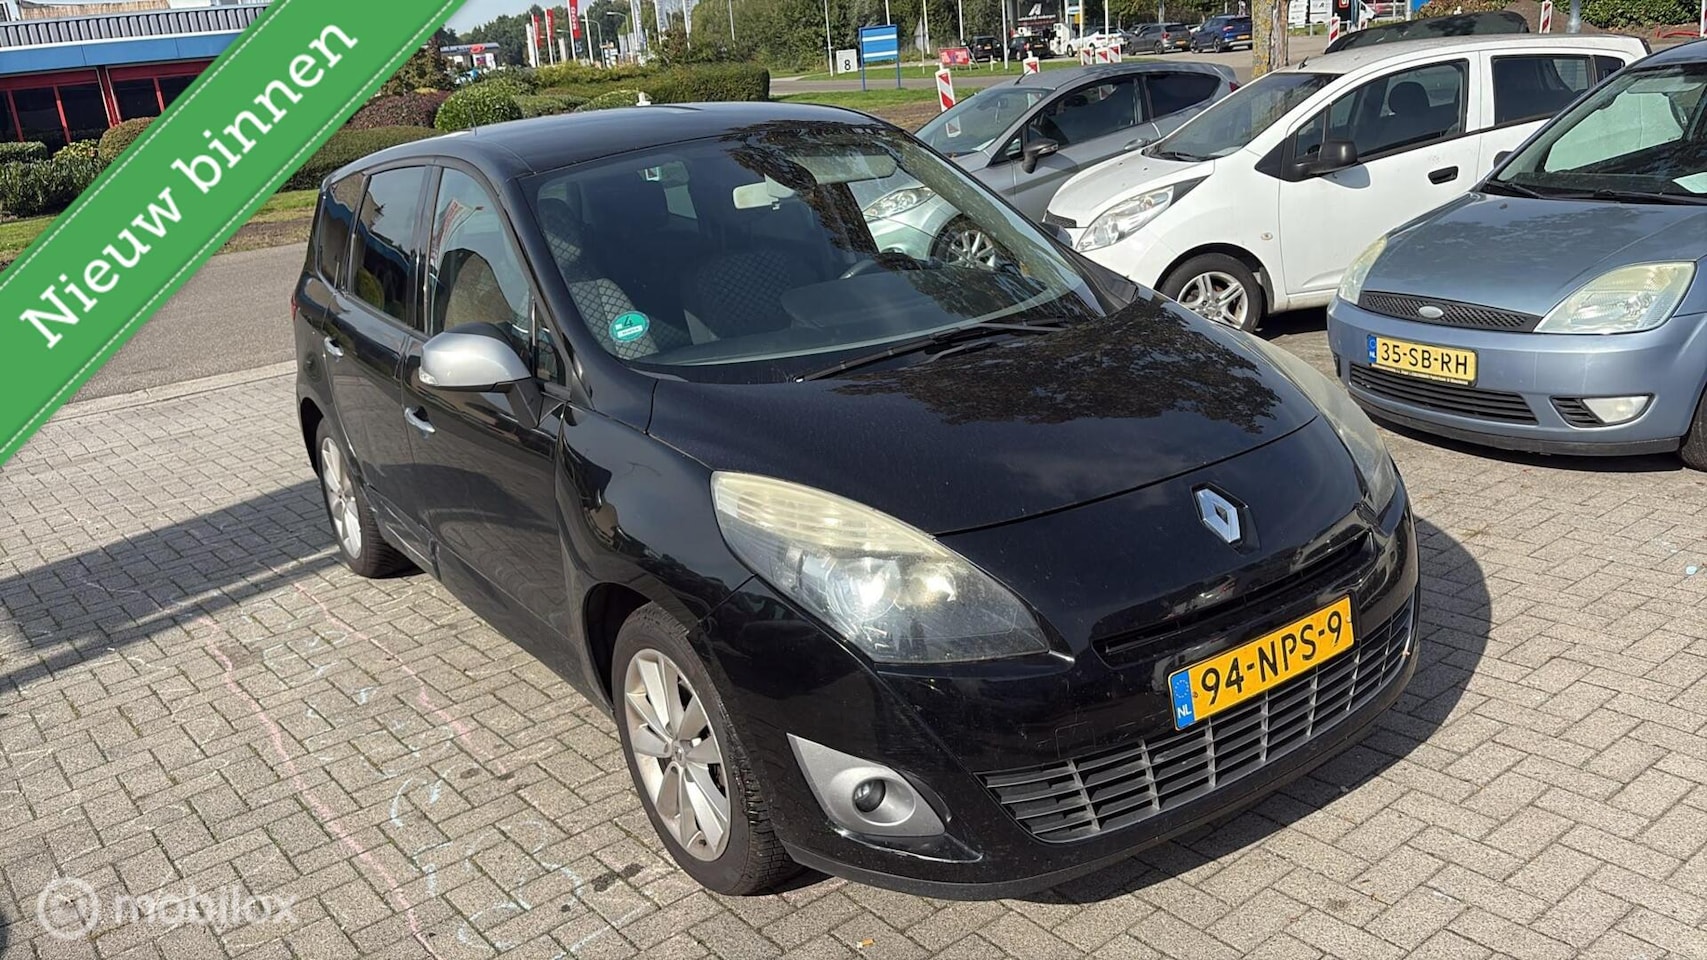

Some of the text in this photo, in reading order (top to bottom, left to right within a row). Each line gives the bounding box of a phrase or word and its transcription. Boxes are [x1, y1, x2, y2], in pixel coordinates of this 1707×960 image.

[844, 59, 851, 71] 8
[624, 315, 634, 327] 4
[1381, 342, 1468, 375] 35-SB-RH
[1201, 610, 1343, 706] 94-NPS-9
[1177, 704, 1192, 719] NL
